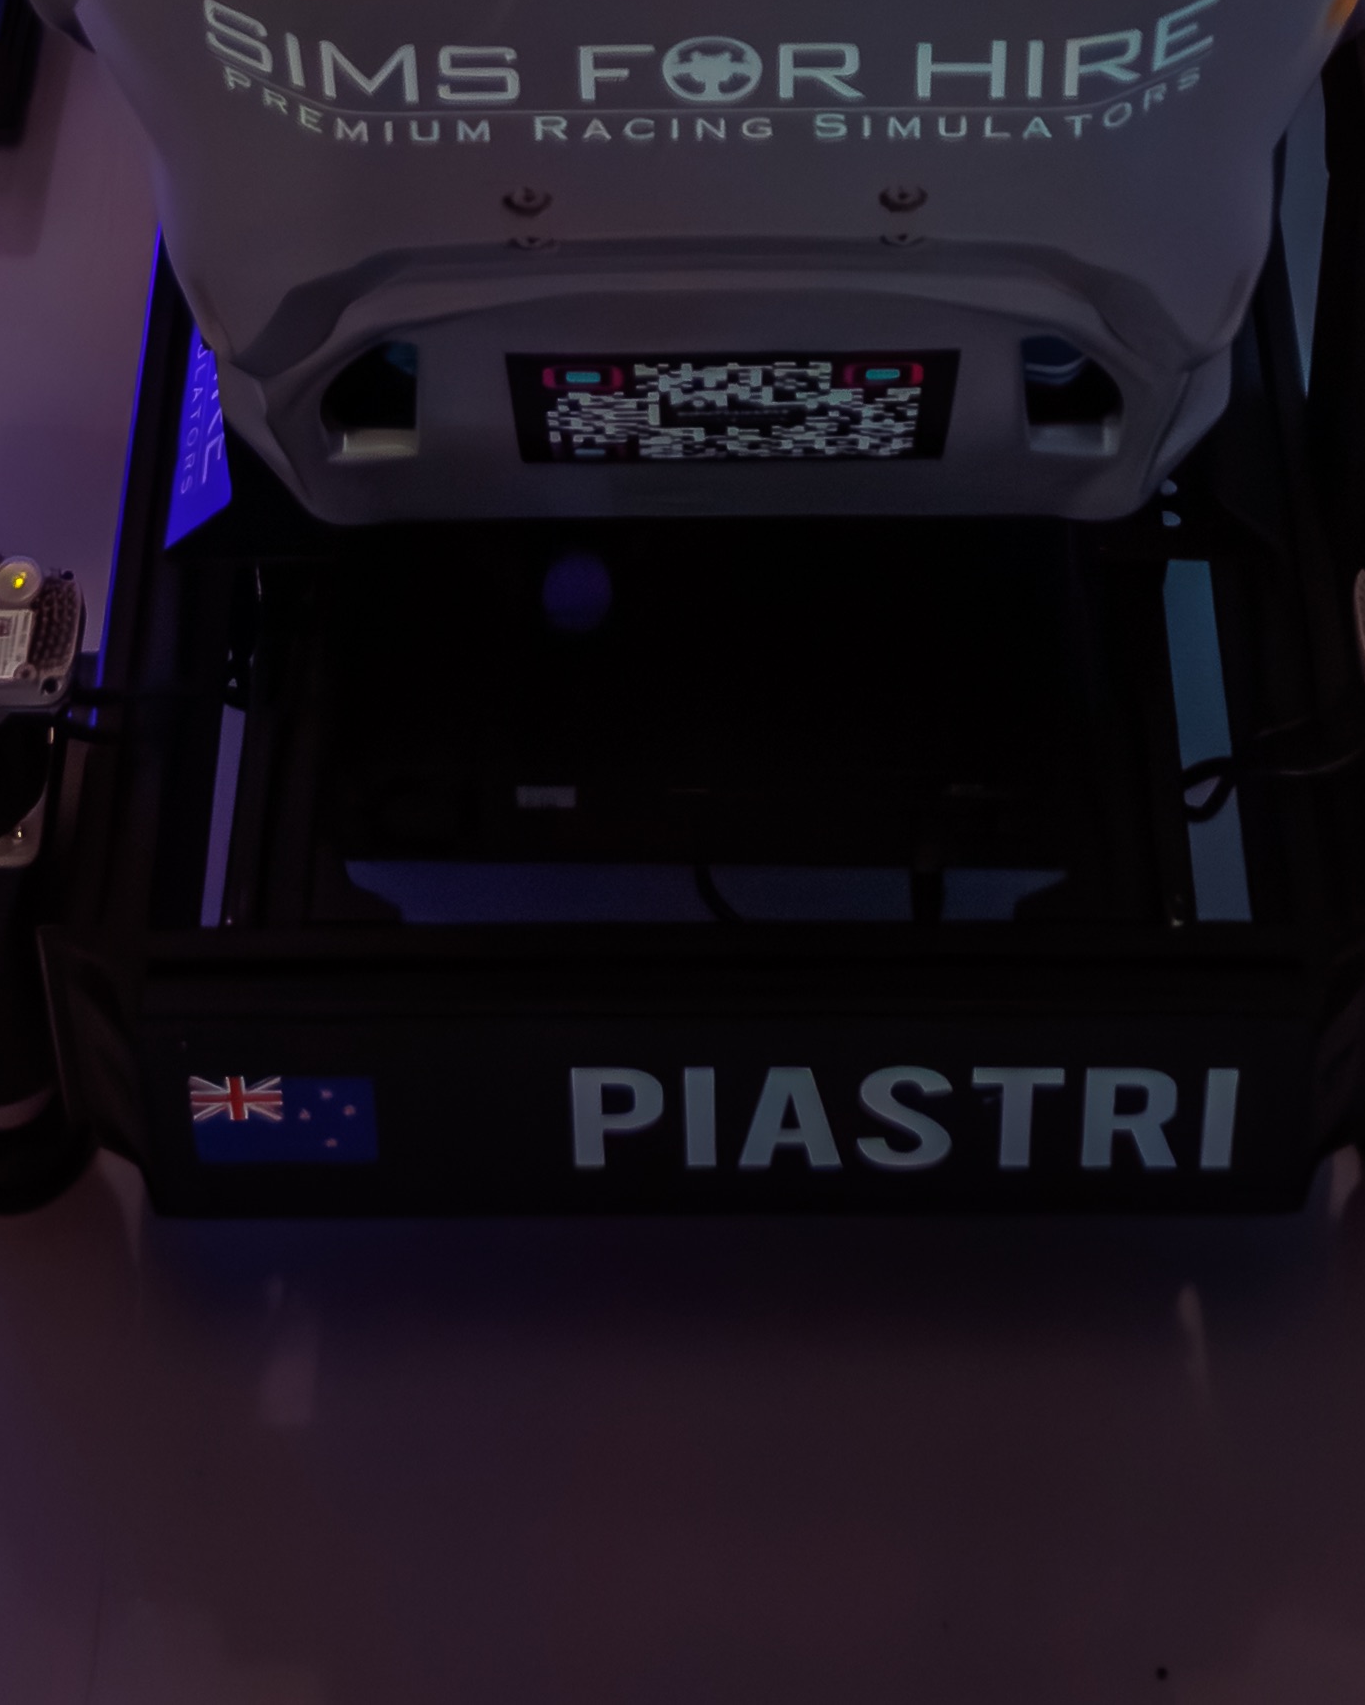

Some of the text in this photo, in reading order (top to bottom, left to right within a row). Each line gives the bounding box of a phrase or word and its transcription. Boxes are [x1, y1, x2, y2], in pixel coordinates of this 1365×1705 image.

[223, 65, 1201, 144] PREMIUM RACING SIMULATORS
[578, 35, 865, 103] FOR
[569, 1064, 1241, 1173] PIASTRI
